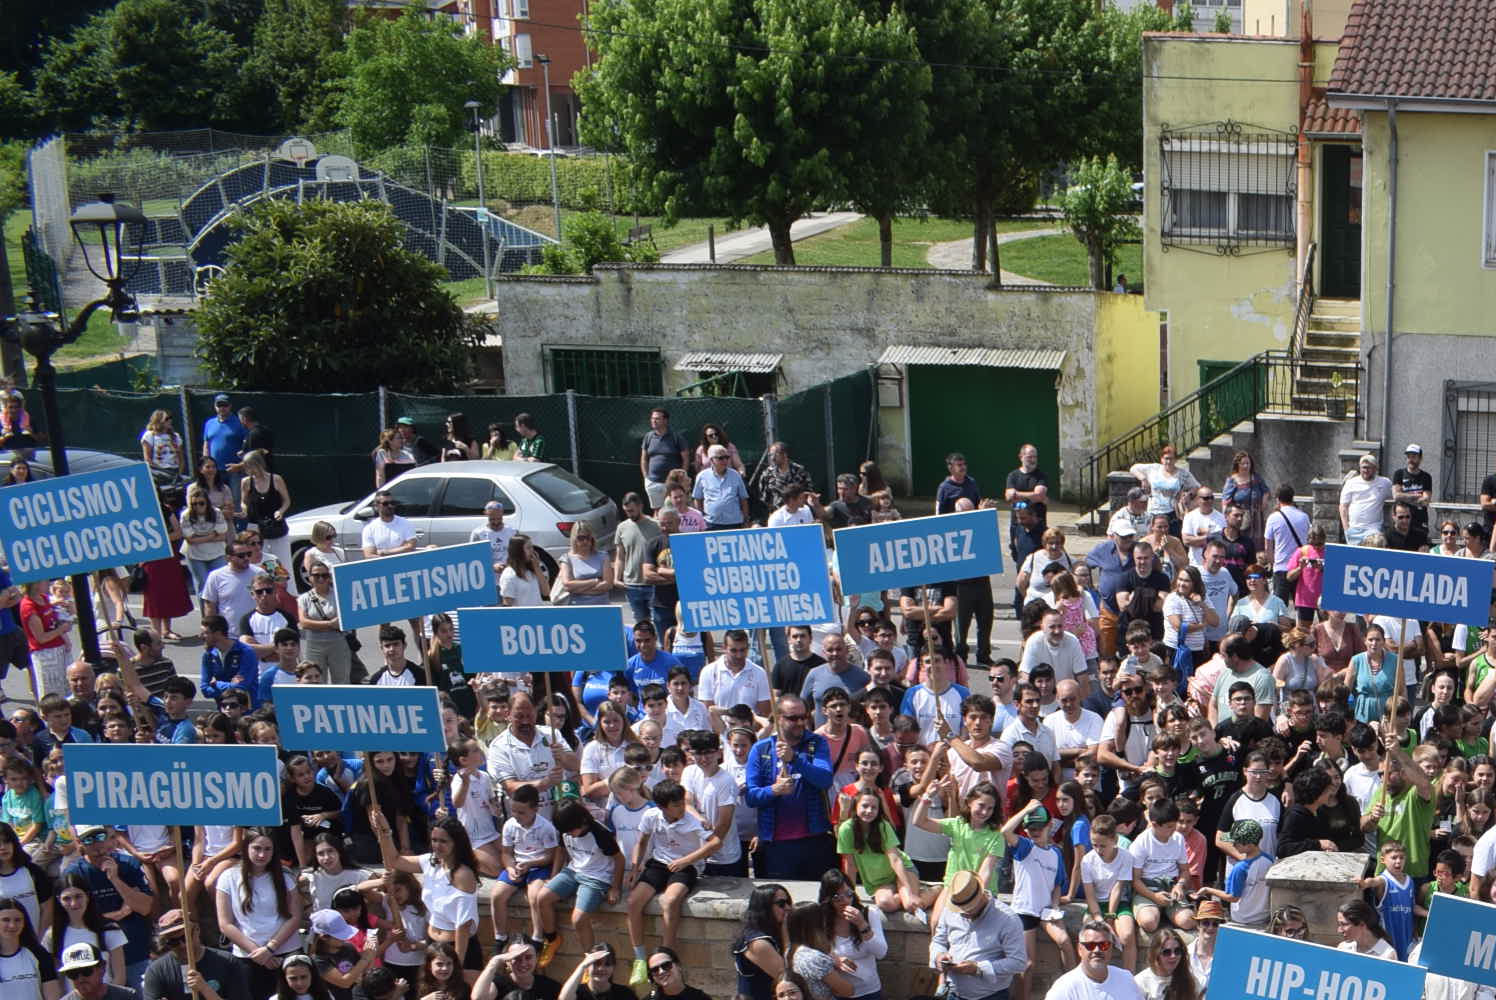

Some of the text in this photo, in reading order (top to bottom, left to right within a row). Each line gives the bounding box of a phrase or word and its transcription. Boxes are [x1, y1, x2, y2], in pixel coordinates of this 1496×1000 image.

[9, 477, 138, 530] CICLISMO Y
[12, 517, 163, 573] CICLOCROSS
[705, 532, 789, 562] PETANCA
[868, 529, 977, 574] AJEDREZ
[350, 559, 486, 612] ATLETISMO
[703, 563, 801, 595] SUBBUTEO
[1343, 565, 1468, 607] ESCALADA
[687, 593, 826, 629] TENIS DE MESA
[499, 623, 586, 656] BOLOS
[292, 704, 428, 735] PATINAJE
[74, 762, 276, 809] PIRAGÜISMO
